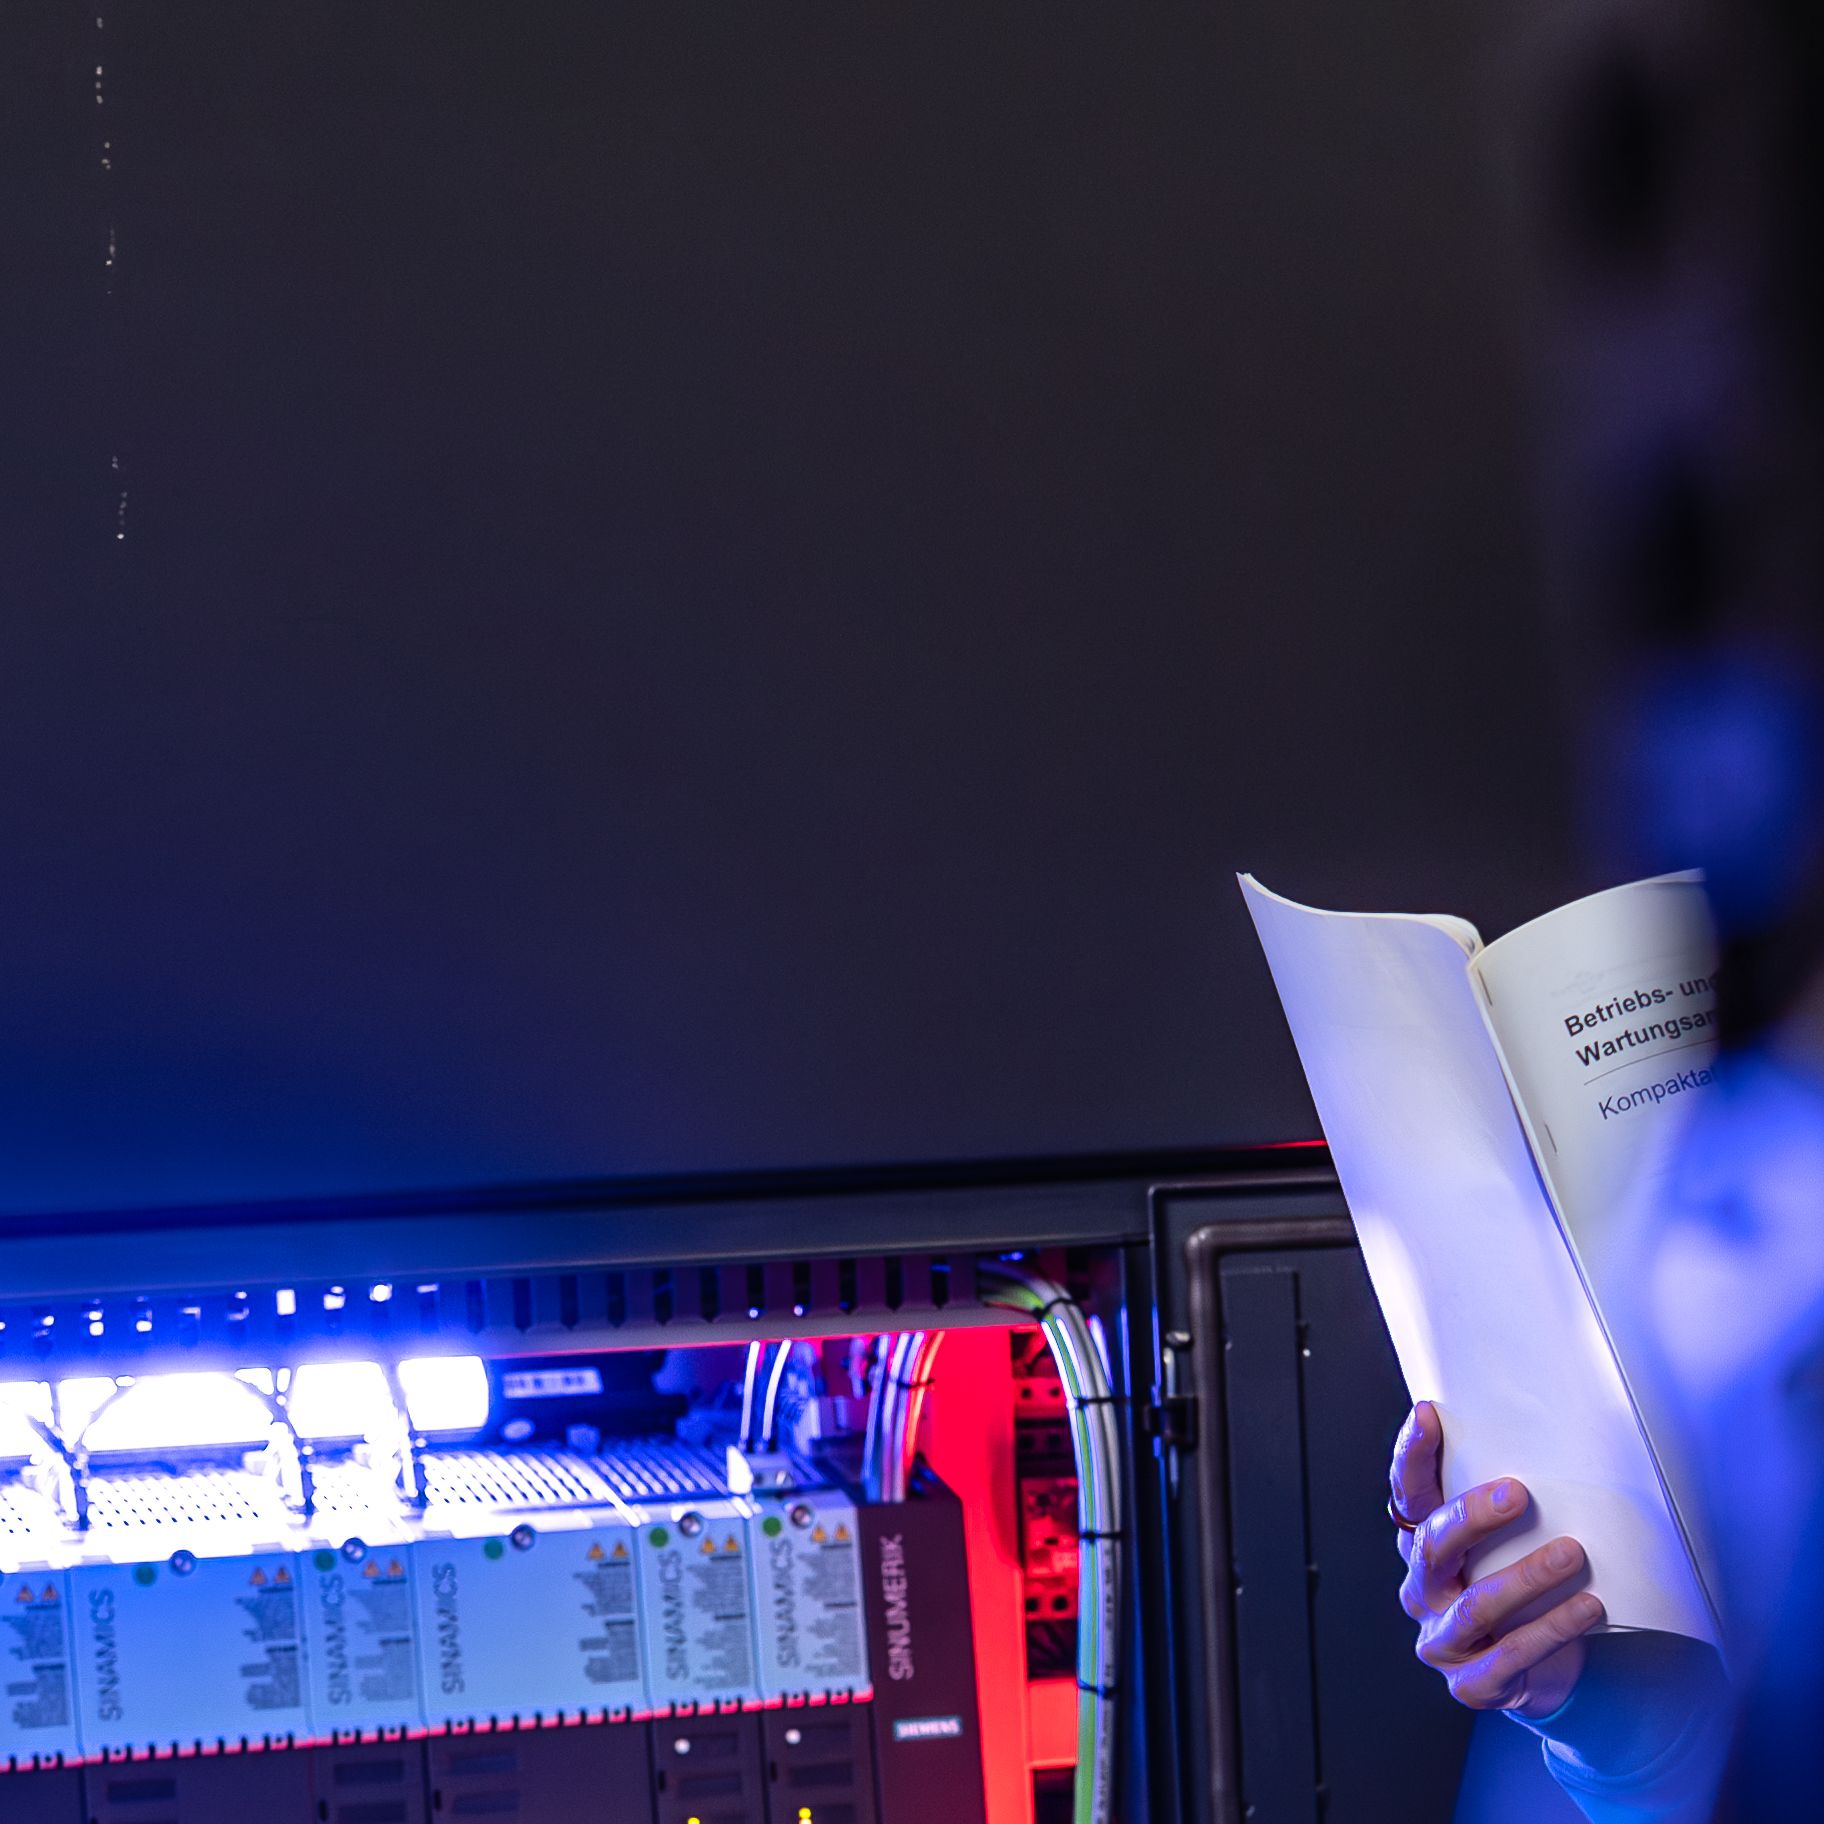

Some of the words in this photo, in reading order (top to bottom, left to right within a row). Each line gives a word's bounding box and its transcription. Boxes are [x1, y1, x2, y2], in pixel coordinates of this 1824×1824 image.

[1564, 986, 1674, 1037] Betriebs-
[86, 1588, 124, 1722] SINAMICS
[319, 1573, 352, 1705] SINAMICS
[431, 1562, 464, 1695] SINAMICS
[661, 1549, 691, 1681] SINAMICS
[769, 1538, 800, 1668] SINAMICS
[888, 1533, 916, 1681] SINUMERIK
